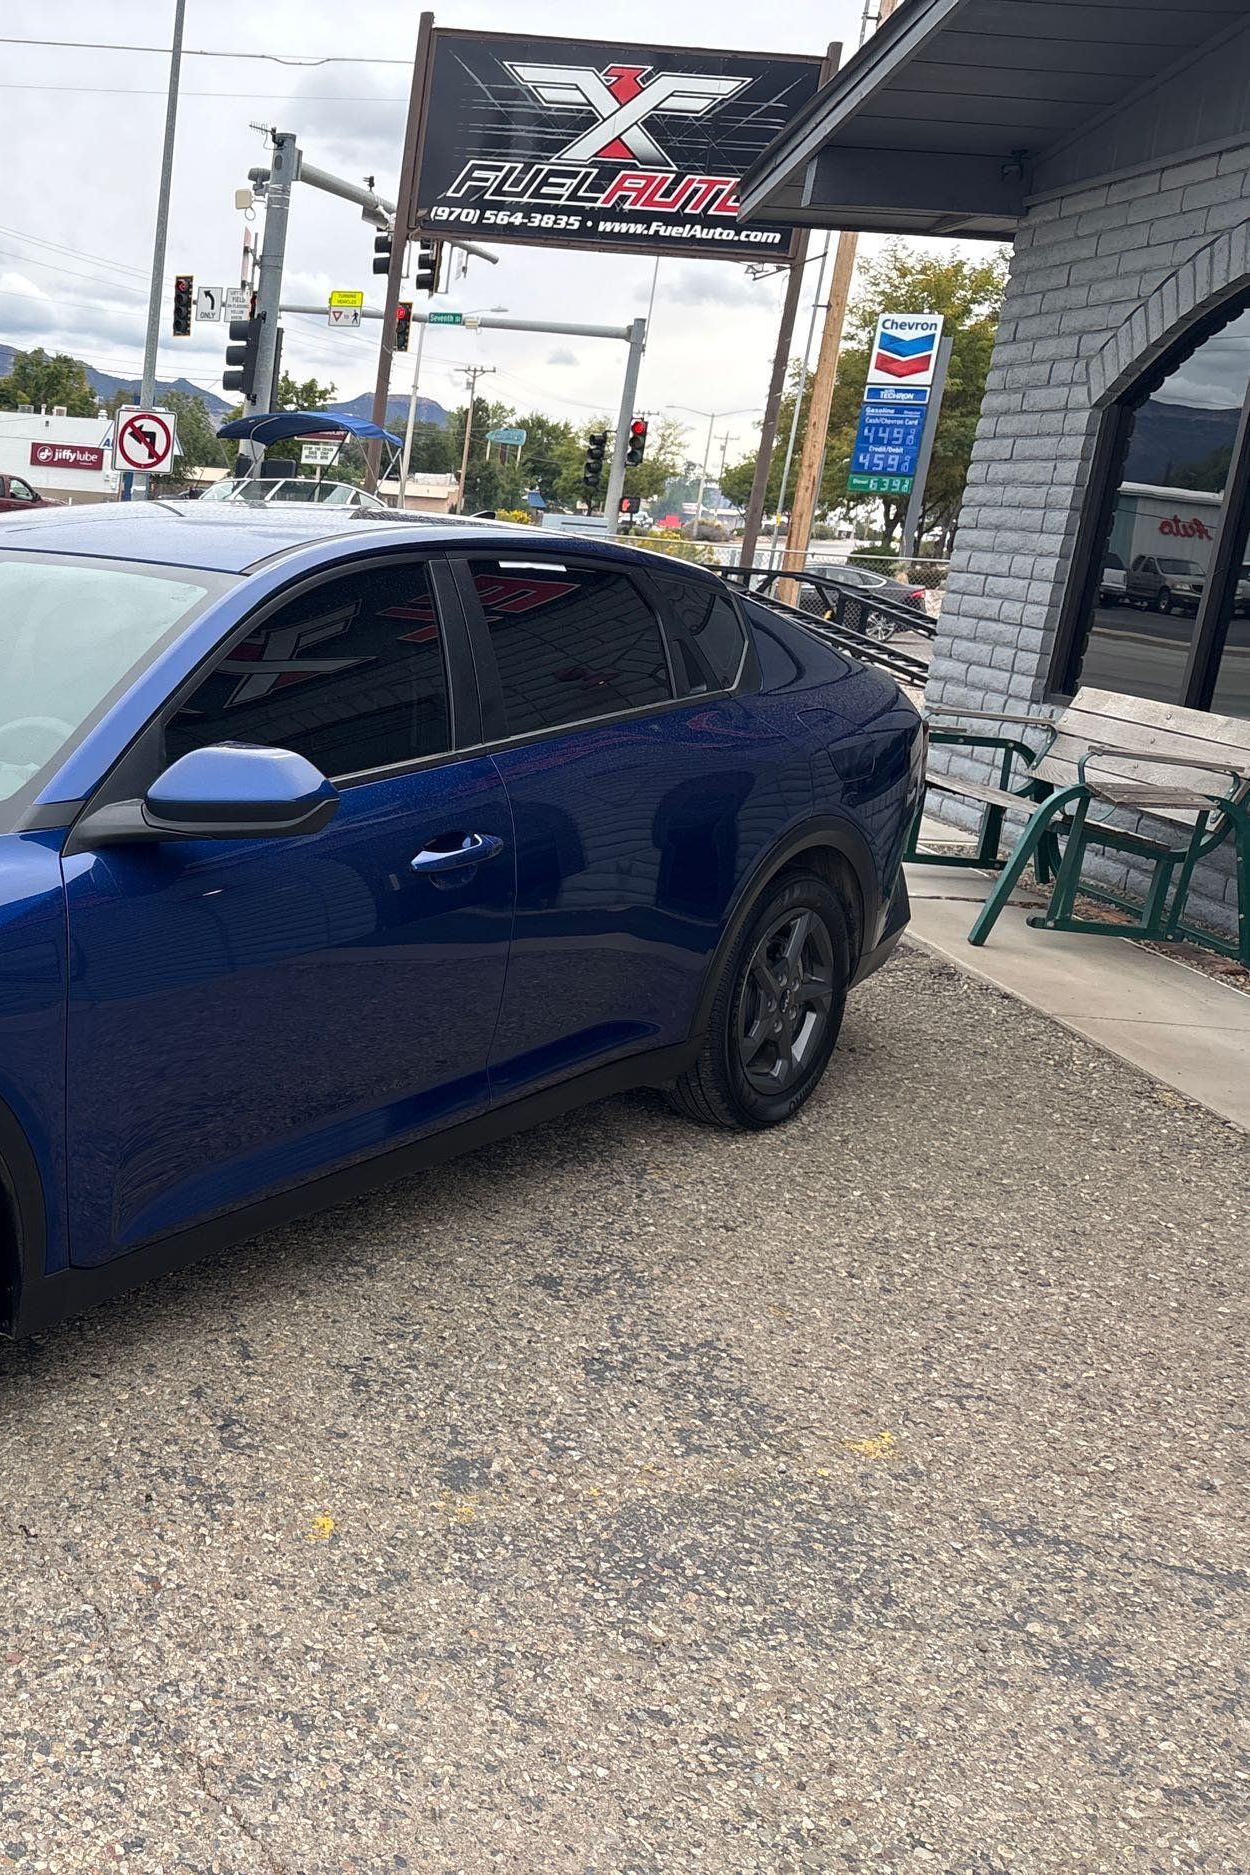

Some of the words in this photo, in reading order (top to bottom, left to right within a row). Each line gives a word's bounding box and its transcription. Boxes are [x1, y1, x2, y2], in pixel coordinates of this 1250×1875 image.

[430, 206, 480, 224] (970)
[482, 210, 582, 230] 564-3835
[598, 220, 782, 244] www.FuelAuto.com
[200, 311, 216, 319] ONLY
[429, 313, 454, 322] Seventh
[881, 318, 938, 331] Chevron
[879, 391, 914, 401] TECHRON
[868, 446, 904, 454] Credit/Debit
